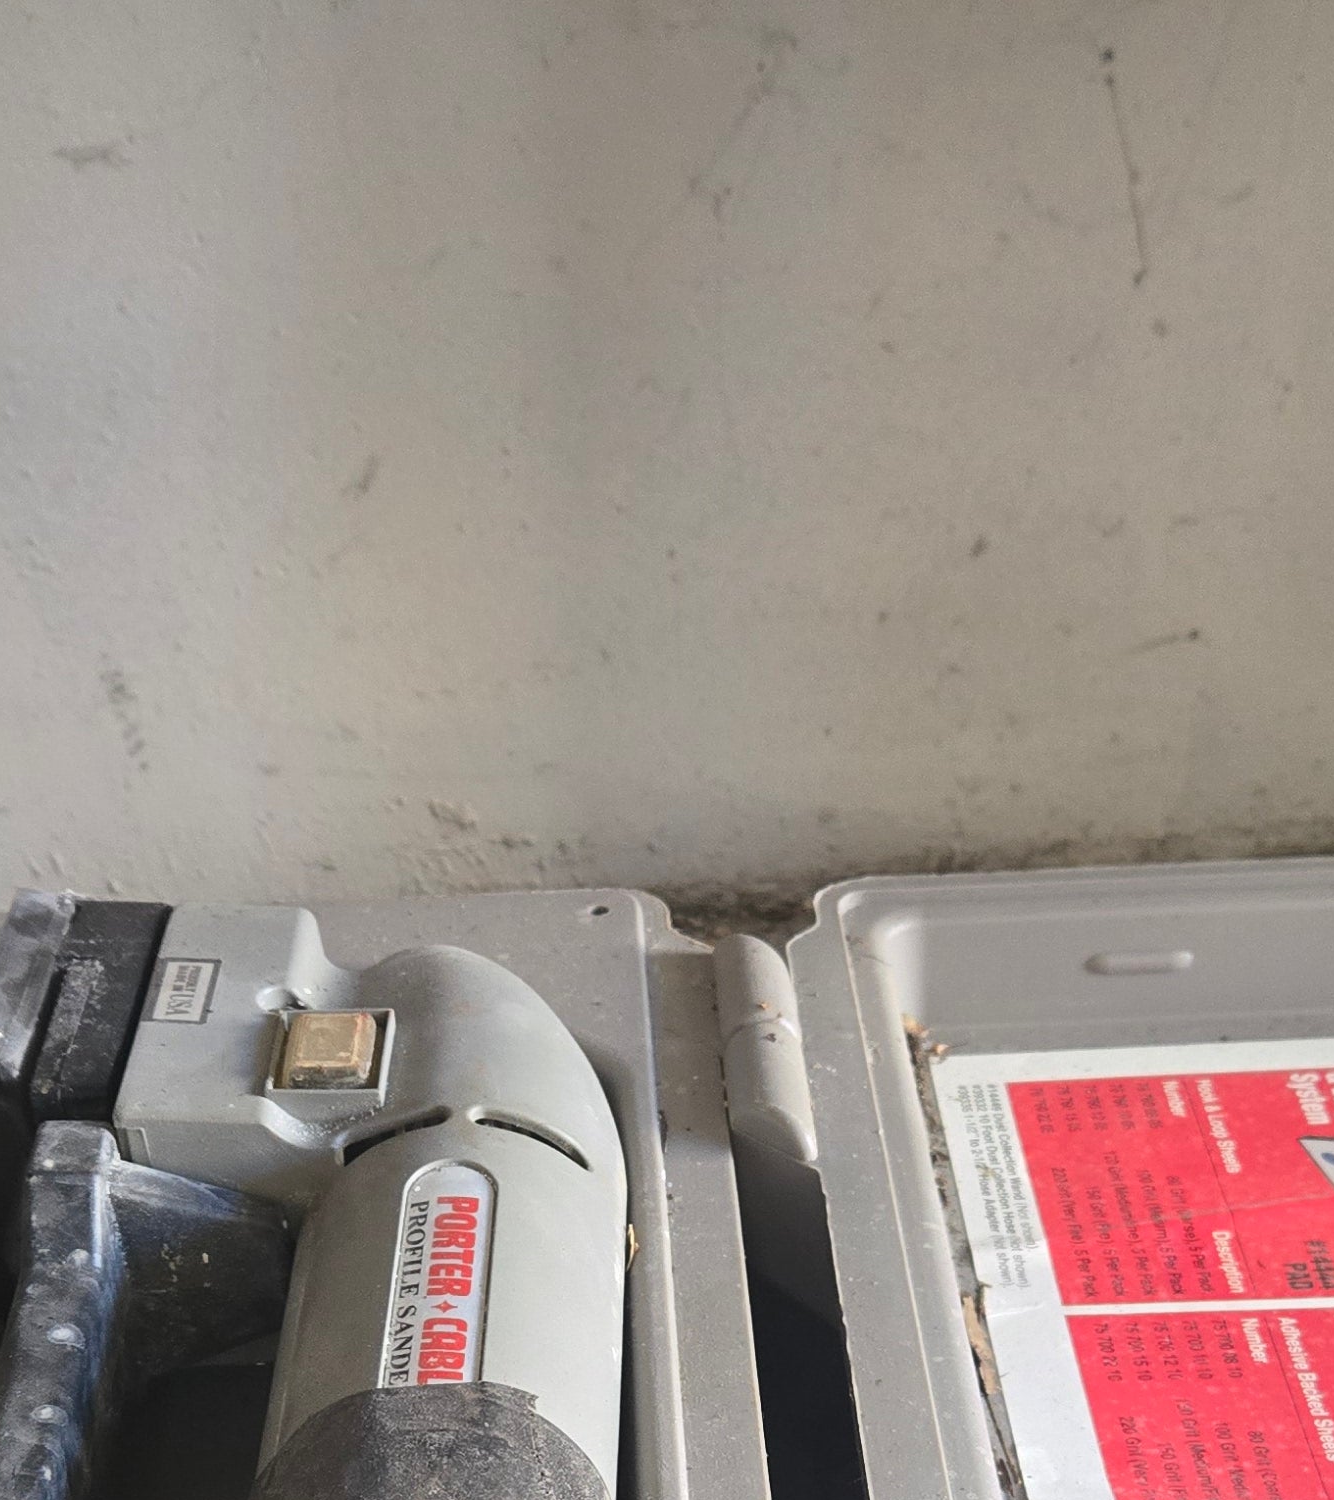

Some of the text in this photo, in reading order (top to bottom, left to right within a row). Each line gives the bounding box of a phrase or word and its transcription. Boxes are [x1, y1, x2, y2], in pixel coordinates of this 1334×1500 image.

[165, 993, 195, 1016] USA
[1161, 1081, 1188, 1117] Number
[981, 1125, 995, 1143] Foot
[992, 1113, 1008, 1132] Dust
[985, 1146, 1001, 1165] Dust
[997, 1134, 1019, 1175] Collection
[1216, 1140, 1243, 1173] Sheets
[977, 1174, 993, 1196] Hose
[990, 1167, 1011, 1208] Collection
[981, 1198, 1001, 1232] Adapter
[1002, 1211, 1017, 1233] Hose
[1211, 1231, 1245, 1294] Description
[1282, 1263, 1315, 1290] PAD
[388, 1200, 429, 1386] PROFILE SANDE
[417, 1196, 480, 1386] PORTER CABL
[1239, 1317, 1270, 1363] Number
[1276, 1317, 1312, 1369] Adhesive
[1296, 1372, 1329, 1416] Backed
